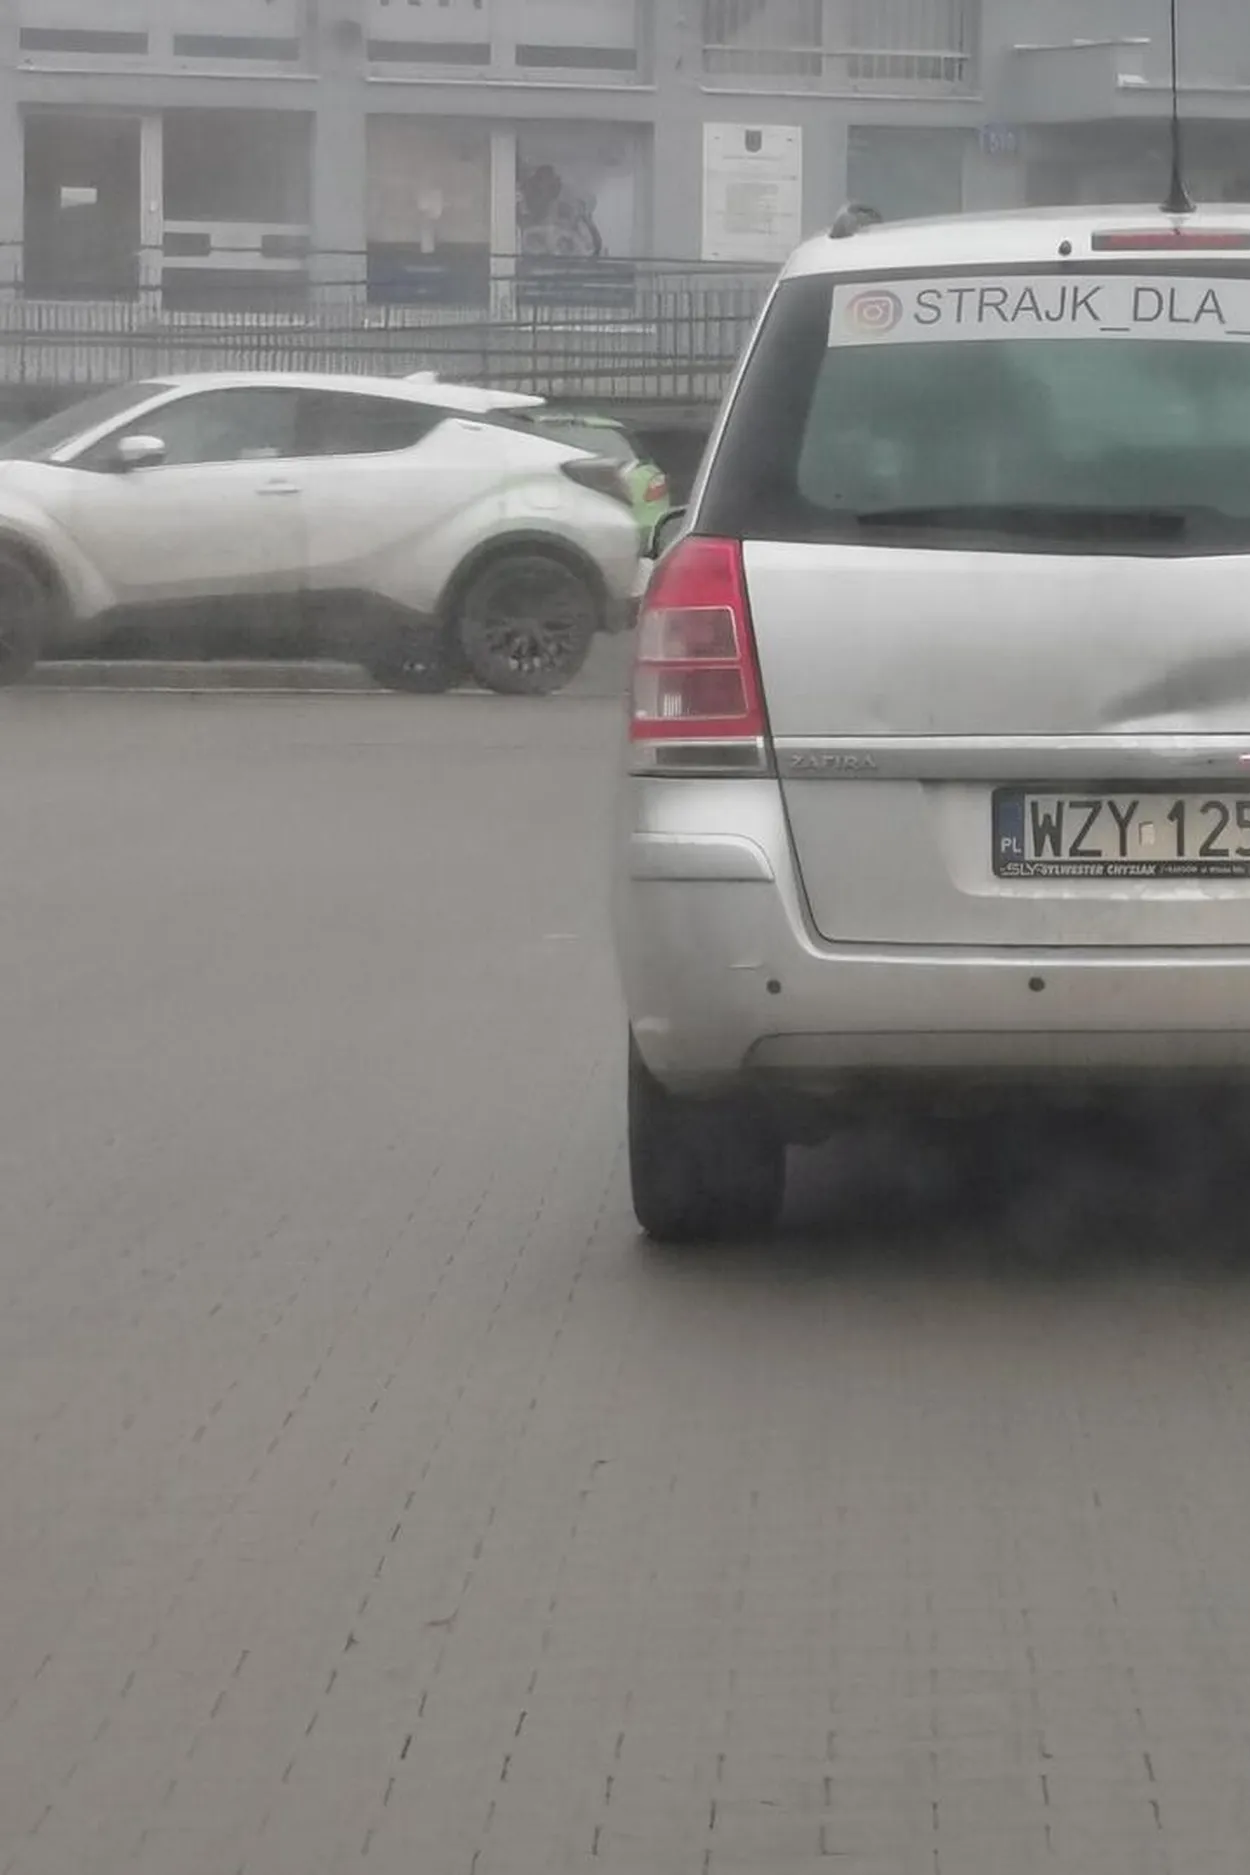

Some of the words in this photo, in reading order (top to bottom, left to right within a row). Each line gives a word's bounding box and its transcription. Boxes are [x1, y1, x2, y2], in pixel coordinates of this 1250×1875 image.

[790, 753, 878, 770] ZAFIRA
[1030, 800, 1139, 858] WZY
[1001, 838, 1021, 852] PL
